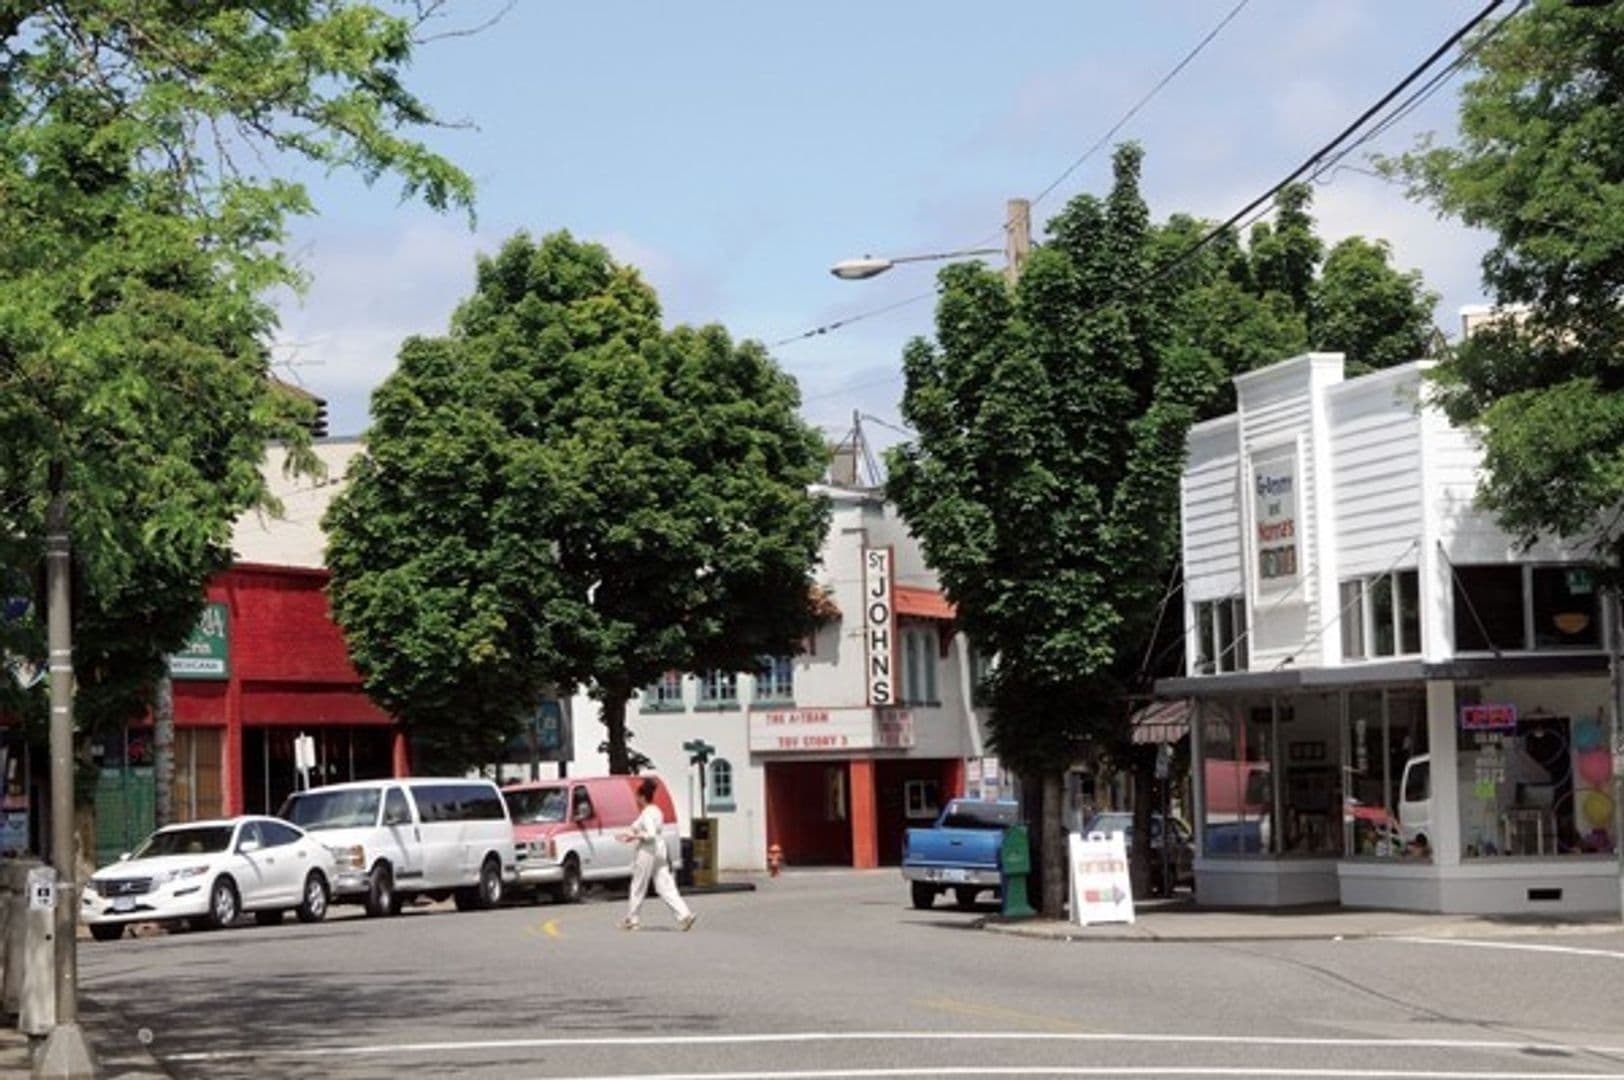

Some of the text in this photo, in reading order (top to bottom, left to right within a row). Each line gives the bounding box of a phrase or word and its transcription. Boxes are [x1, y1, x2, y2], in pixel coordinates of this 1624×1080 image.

[868, 575, 890, 704] JOHNS
[767, 712, 785, 725] THE
[778, 735, 848, 747] TOY STORY 3
